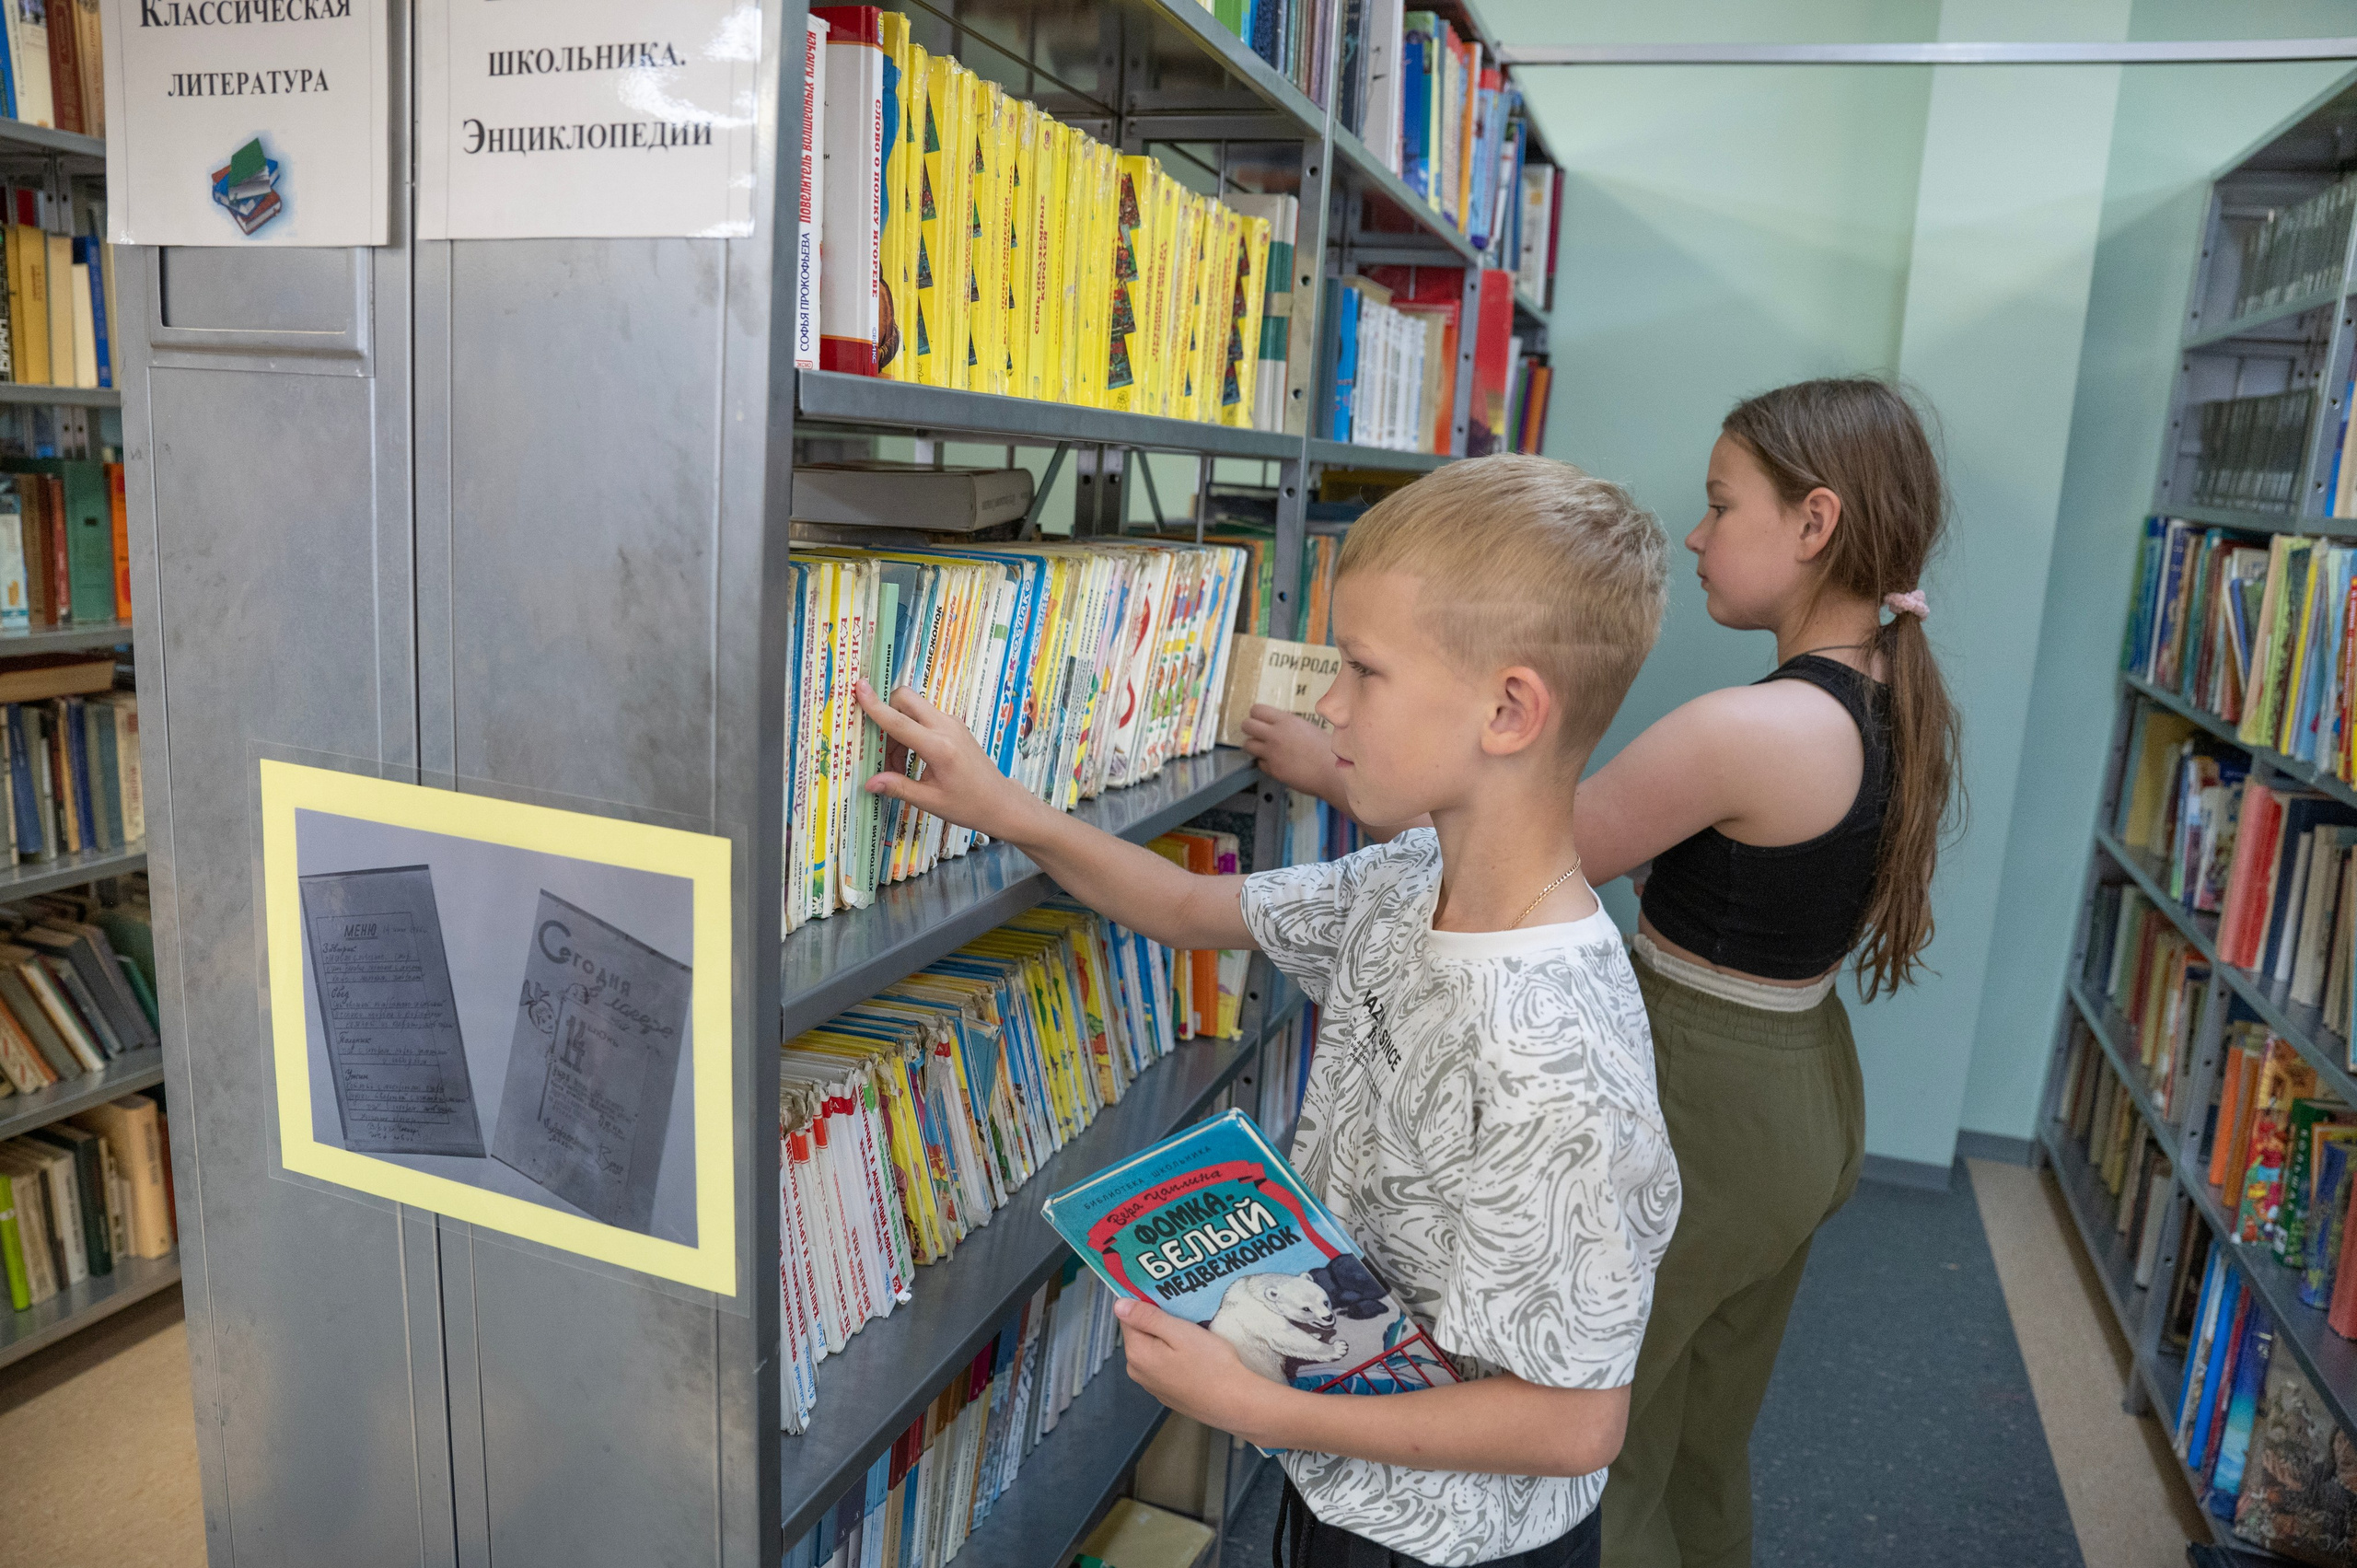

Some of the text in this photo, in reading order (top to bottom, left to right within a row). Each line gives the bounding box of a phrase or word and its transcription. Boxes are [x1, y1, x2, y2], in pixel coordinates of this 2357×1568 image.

[141, 0, 351, 27] КЛАССИЧЕСКАЯ
[168, 69, 330, 97] ЛИТЕРАТУРА
[488, 42, 686, 76] ШКОЛЬНИКА.
[462, 118, 713, 157] ЭНЦИКЛОПЕДИИ
[874, 159, 880, 168] О
[1036, 194, 1044, 290] ПОДЗЕМНЫХ
[800, 233, 810, 352] СОФЬЯ ПРОКОФЬЕВА
[922, 604, 943, 687] МЕДВЕЖОНОК
[939, 595, 957, 672] ДОМИШКИ
[970, 668, 986, 732] РАССКАЗЫ
[985, 587, 1002, 652] ЖИВОТНЫХ
[1269, 652, 1340, 675] ПРИРОДА
[816, 621, 828, 738] ТОЛСТЯКА
[834, 616, 848, 732] ТОЛСТЯКА
[844, 615, 862, 781] ТРИ ТОЛСТЯКА
[883, 644, 891, 703] ХОТВОРЕНИЯ
[1295, 684, 1307, 695] И
[867, 760, 882, 891] ХРЕСТОМАТИЯ ШКОЛКА
[344, 923, 377, 937] МЕНЮ
[538, 920, 632, 996] Сегодня
[331, 986, 350, 1004] Обед
[345, 1069, 368, 1081] Ужин
[1379, 1029, 1401, 1073] SINCE
[784, 1139, 799, 1201] РАССКАЗЫ
[856, 1082, 873, 1153] ЩЕЛКУНЧИК
[871, 1167, 888, 1228] МЫШИНЫЙ
[882, 1228, 895, 1269] КОРОЛЬ
[1084, 1145, 1213, 1210] БИБЛИОТЕКА ШКОЛЬНИКА
[1107, 1169, 1223, 1226] Вера Чаплина
[795, 1200, 807, 1245] ДРУГИЕ
[871, 1207, 884, 1254] ПРИНЦ
[1133, 1191, 1235, 1246] ФОМКА-
[1136, 1197, 1280, 1281] БЕЛЫЙ
[850, 1225, 872, 1312] ВРЕМЕНА ГОДА
[1155, 1225, 1303, 1301] МЕДВЕЖОНОК
[790, 1258, 806, 1337] ДЕНИСКИНЫ
